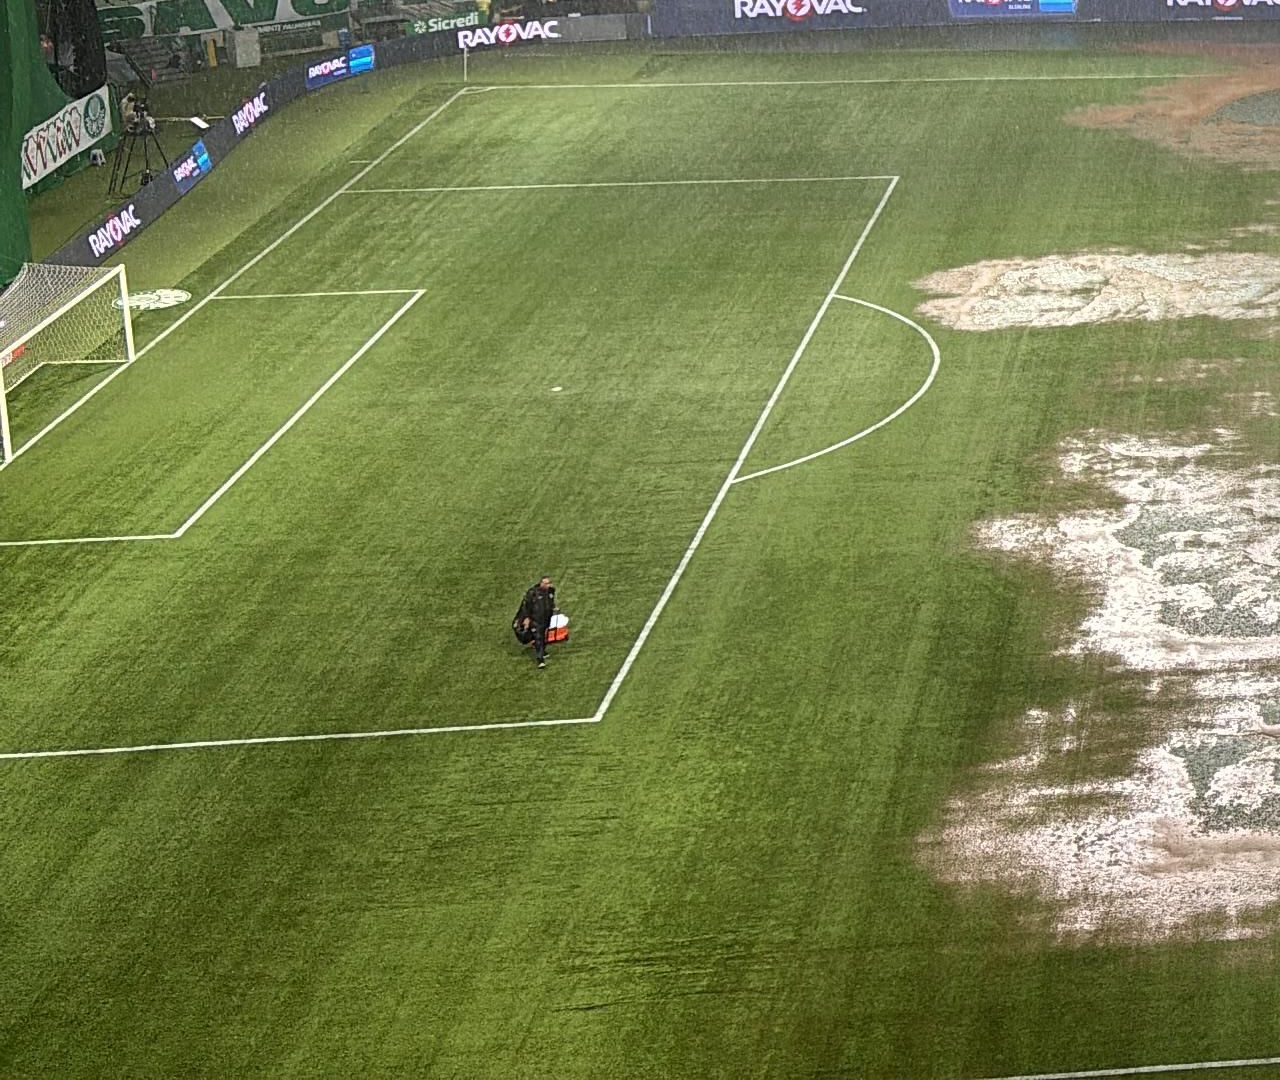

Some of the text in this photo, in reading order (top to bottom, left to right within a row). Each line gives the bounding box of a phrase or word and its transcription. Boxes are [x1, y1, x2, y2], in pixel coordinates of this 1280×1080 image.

[429, 12, 478, 33] Sicredi
[458, 20, 560, 49] RAYOVAC
[309, 56, 347, 78] RAYOVAC
[232, 92, 269, 135] RAYOVAC
[88, 204, 141, 258] RAYOVAC
